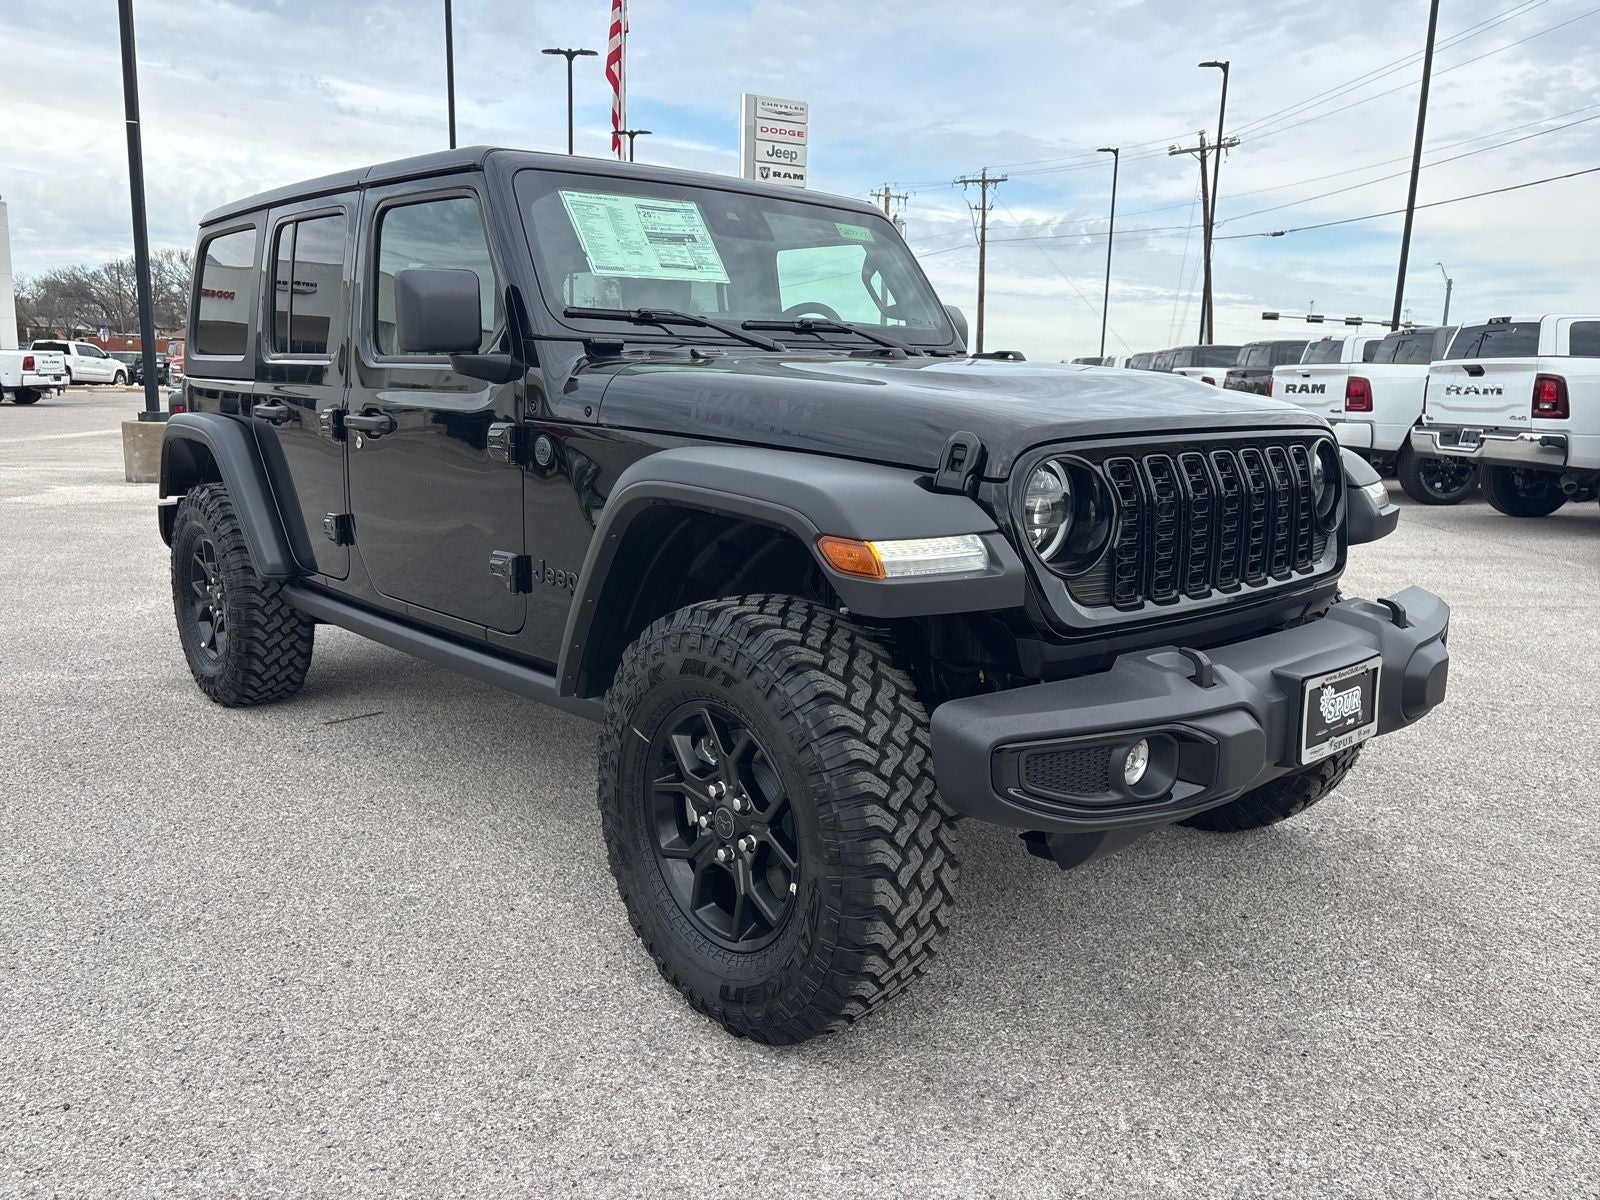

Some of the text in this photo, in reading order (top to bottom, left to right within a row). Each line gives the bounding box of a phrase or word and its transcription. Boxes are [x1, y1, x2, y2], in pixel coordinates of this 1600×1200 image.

[761, 101, 805, 112] CHRYSLER
[760, 126, 805, 138] DODGE
[766, 144, 798, 162] Jeep
[772, 171, 804, 181] RAM
[1285, 383, 1326, 394] RAM
[1446, 383, 1504, 396] RAM
[532, 559, 580, 596] Jeep
[1327, 688, 1361, 721] SPUR
[1334, 736, 1354, 751] SPUR
